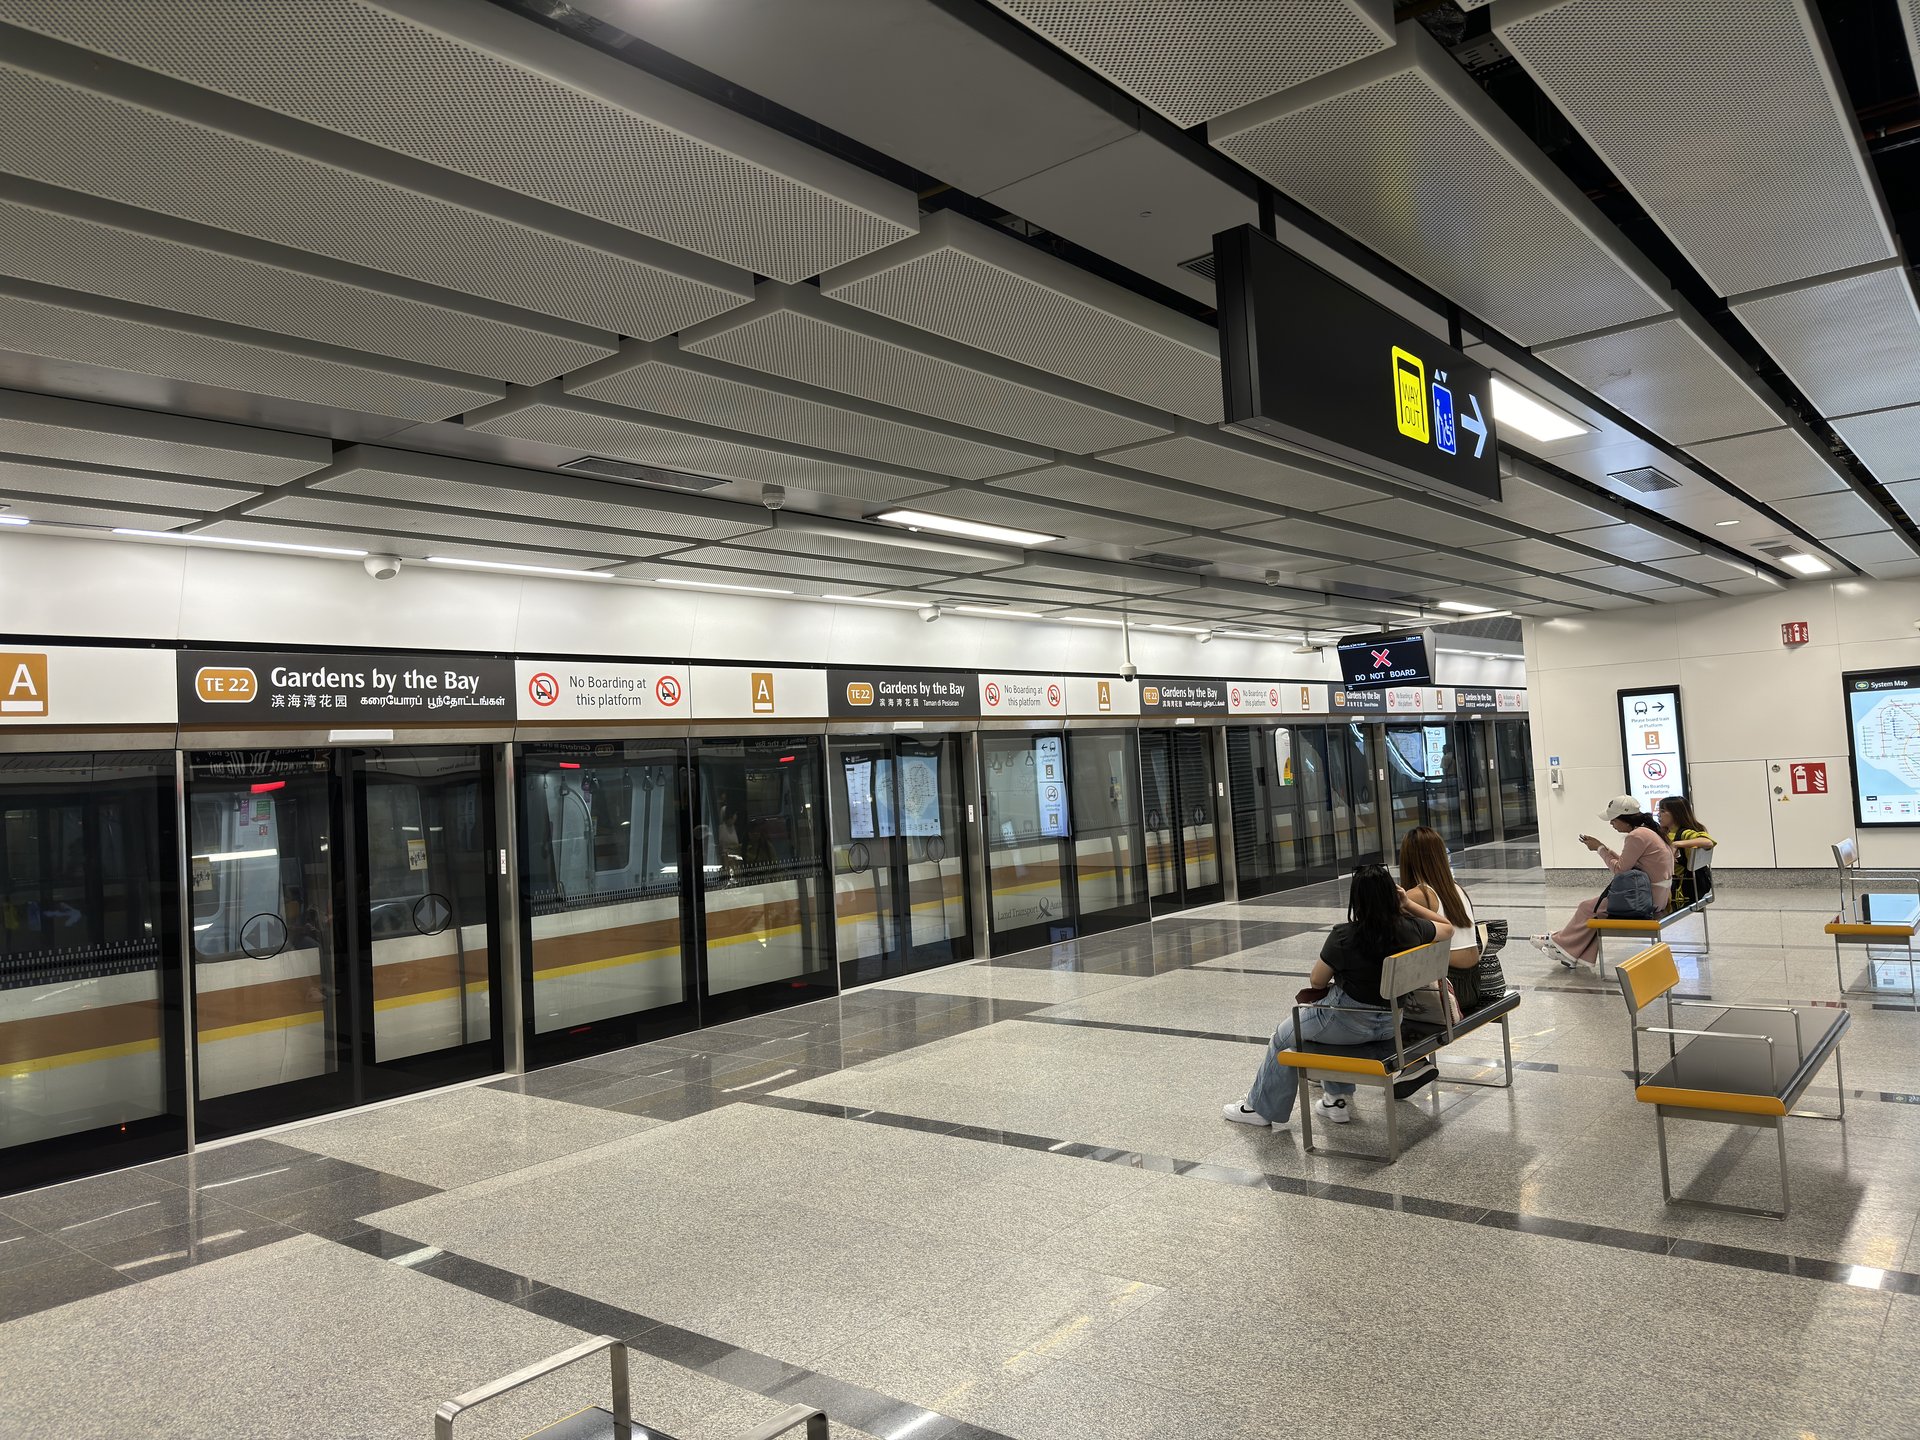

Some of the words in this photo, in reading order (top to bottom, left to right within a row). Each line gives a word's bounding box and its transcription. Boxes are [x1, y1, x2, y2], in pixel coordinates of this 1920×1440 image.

[1402, 382, 1419, 405] WAY
[1404, 406, 1420, 428] OUT
[8, 663, 38, 695] A
[270, 666, 365, 689] Gardens
[372, 668, 397, 693] by
[403, 668, 438, 689] the
[444, 671, 480, 694] Bay
[1370, 672, 1385, 680] NOT
[1389, 668, 1416, 678] BOARD
[203, 677, 224, 692] TE
[228, 677, 250, 692] 22
[569, 676, 585, 688] No
[588, 676, 634, 691] Boarding
[636, 678, 647, 689] at
[757, 679, 770, 700] A
[879, 681, 917, 694] Gardens
[919, 681, 931, 697] by
[932, 682, 948, 695] the
[949, 683, 965, 697] Bay
[1004, 685, 1012, 694] No
[1013, 685, 1036, 696] Boarding
[1037, 686, 1043, 694] at
[1870, 681, 1894, 689] System
[851, 689, 860, 699] TE
[861, 689, 870, 699] 22
[1101, 686, 1109, 701] A
[1161, 687, 1187, 698] Gardens
[1187, 686, 1196, 699] by
[1196, 687, 1206, 698] the
[1207, 687, 1217, 700] Bay
[1303, 691, 1309, 703] A
[271, 694, 348, 708] 滨海湾花园
[576, 694, 596, 706] this
[598, 694, 642, 709] platform
[922, 699, 937, 707] Taman
[1008, 697, 1018, 706] this
[1019, 697, 1041, 708] platform
[1648, 734, 1657, 744] B
[997, 910, 1012, 921] Land
[1012, 906, 1038, 918] Transport
